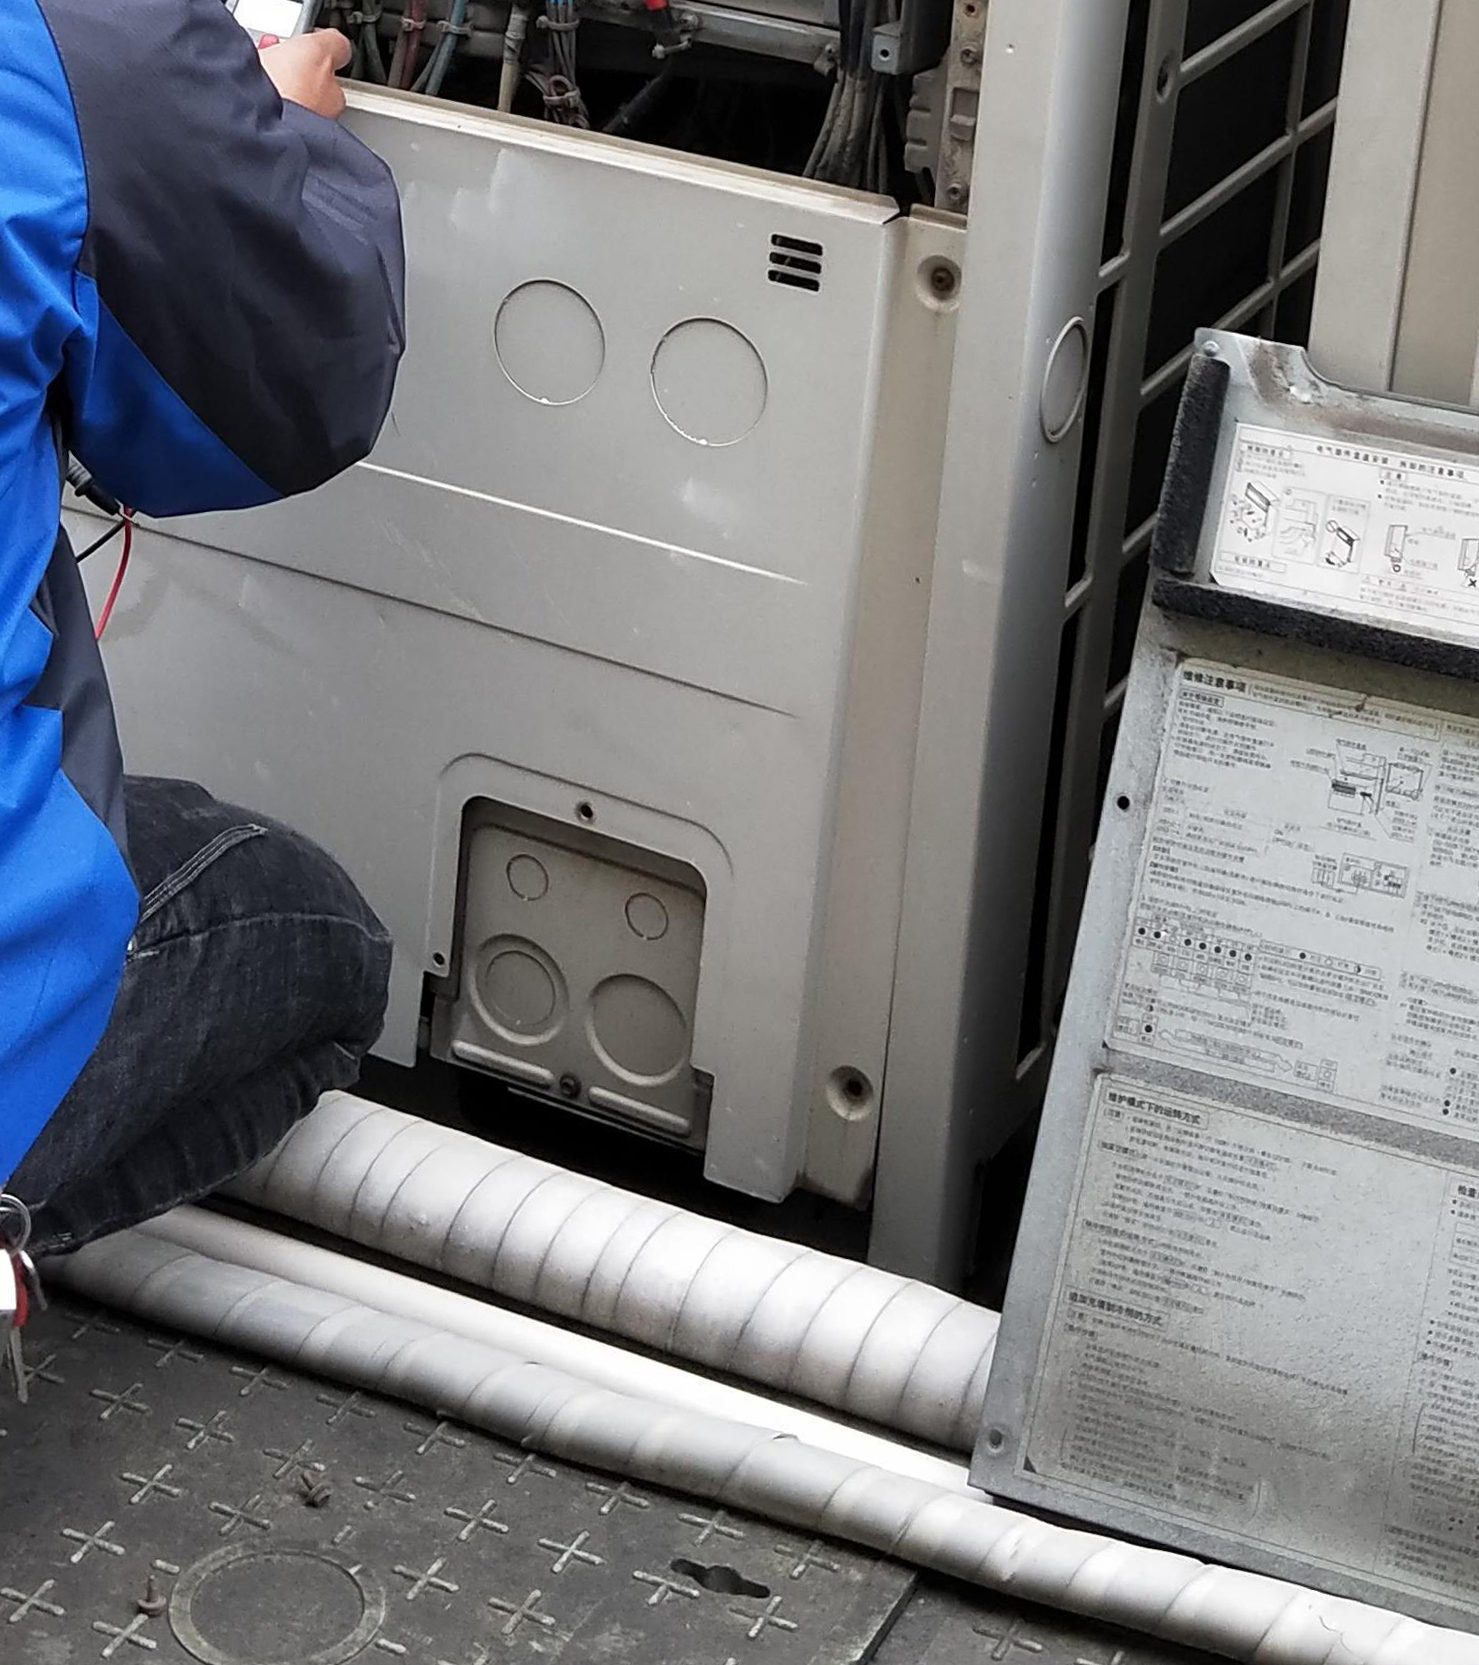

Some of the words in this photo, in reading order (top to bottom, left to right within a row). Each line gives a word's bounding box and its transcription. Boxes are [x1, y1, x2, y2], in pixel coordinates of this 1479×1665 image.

[1182, 670, 1247, 693] 维修注意事项
